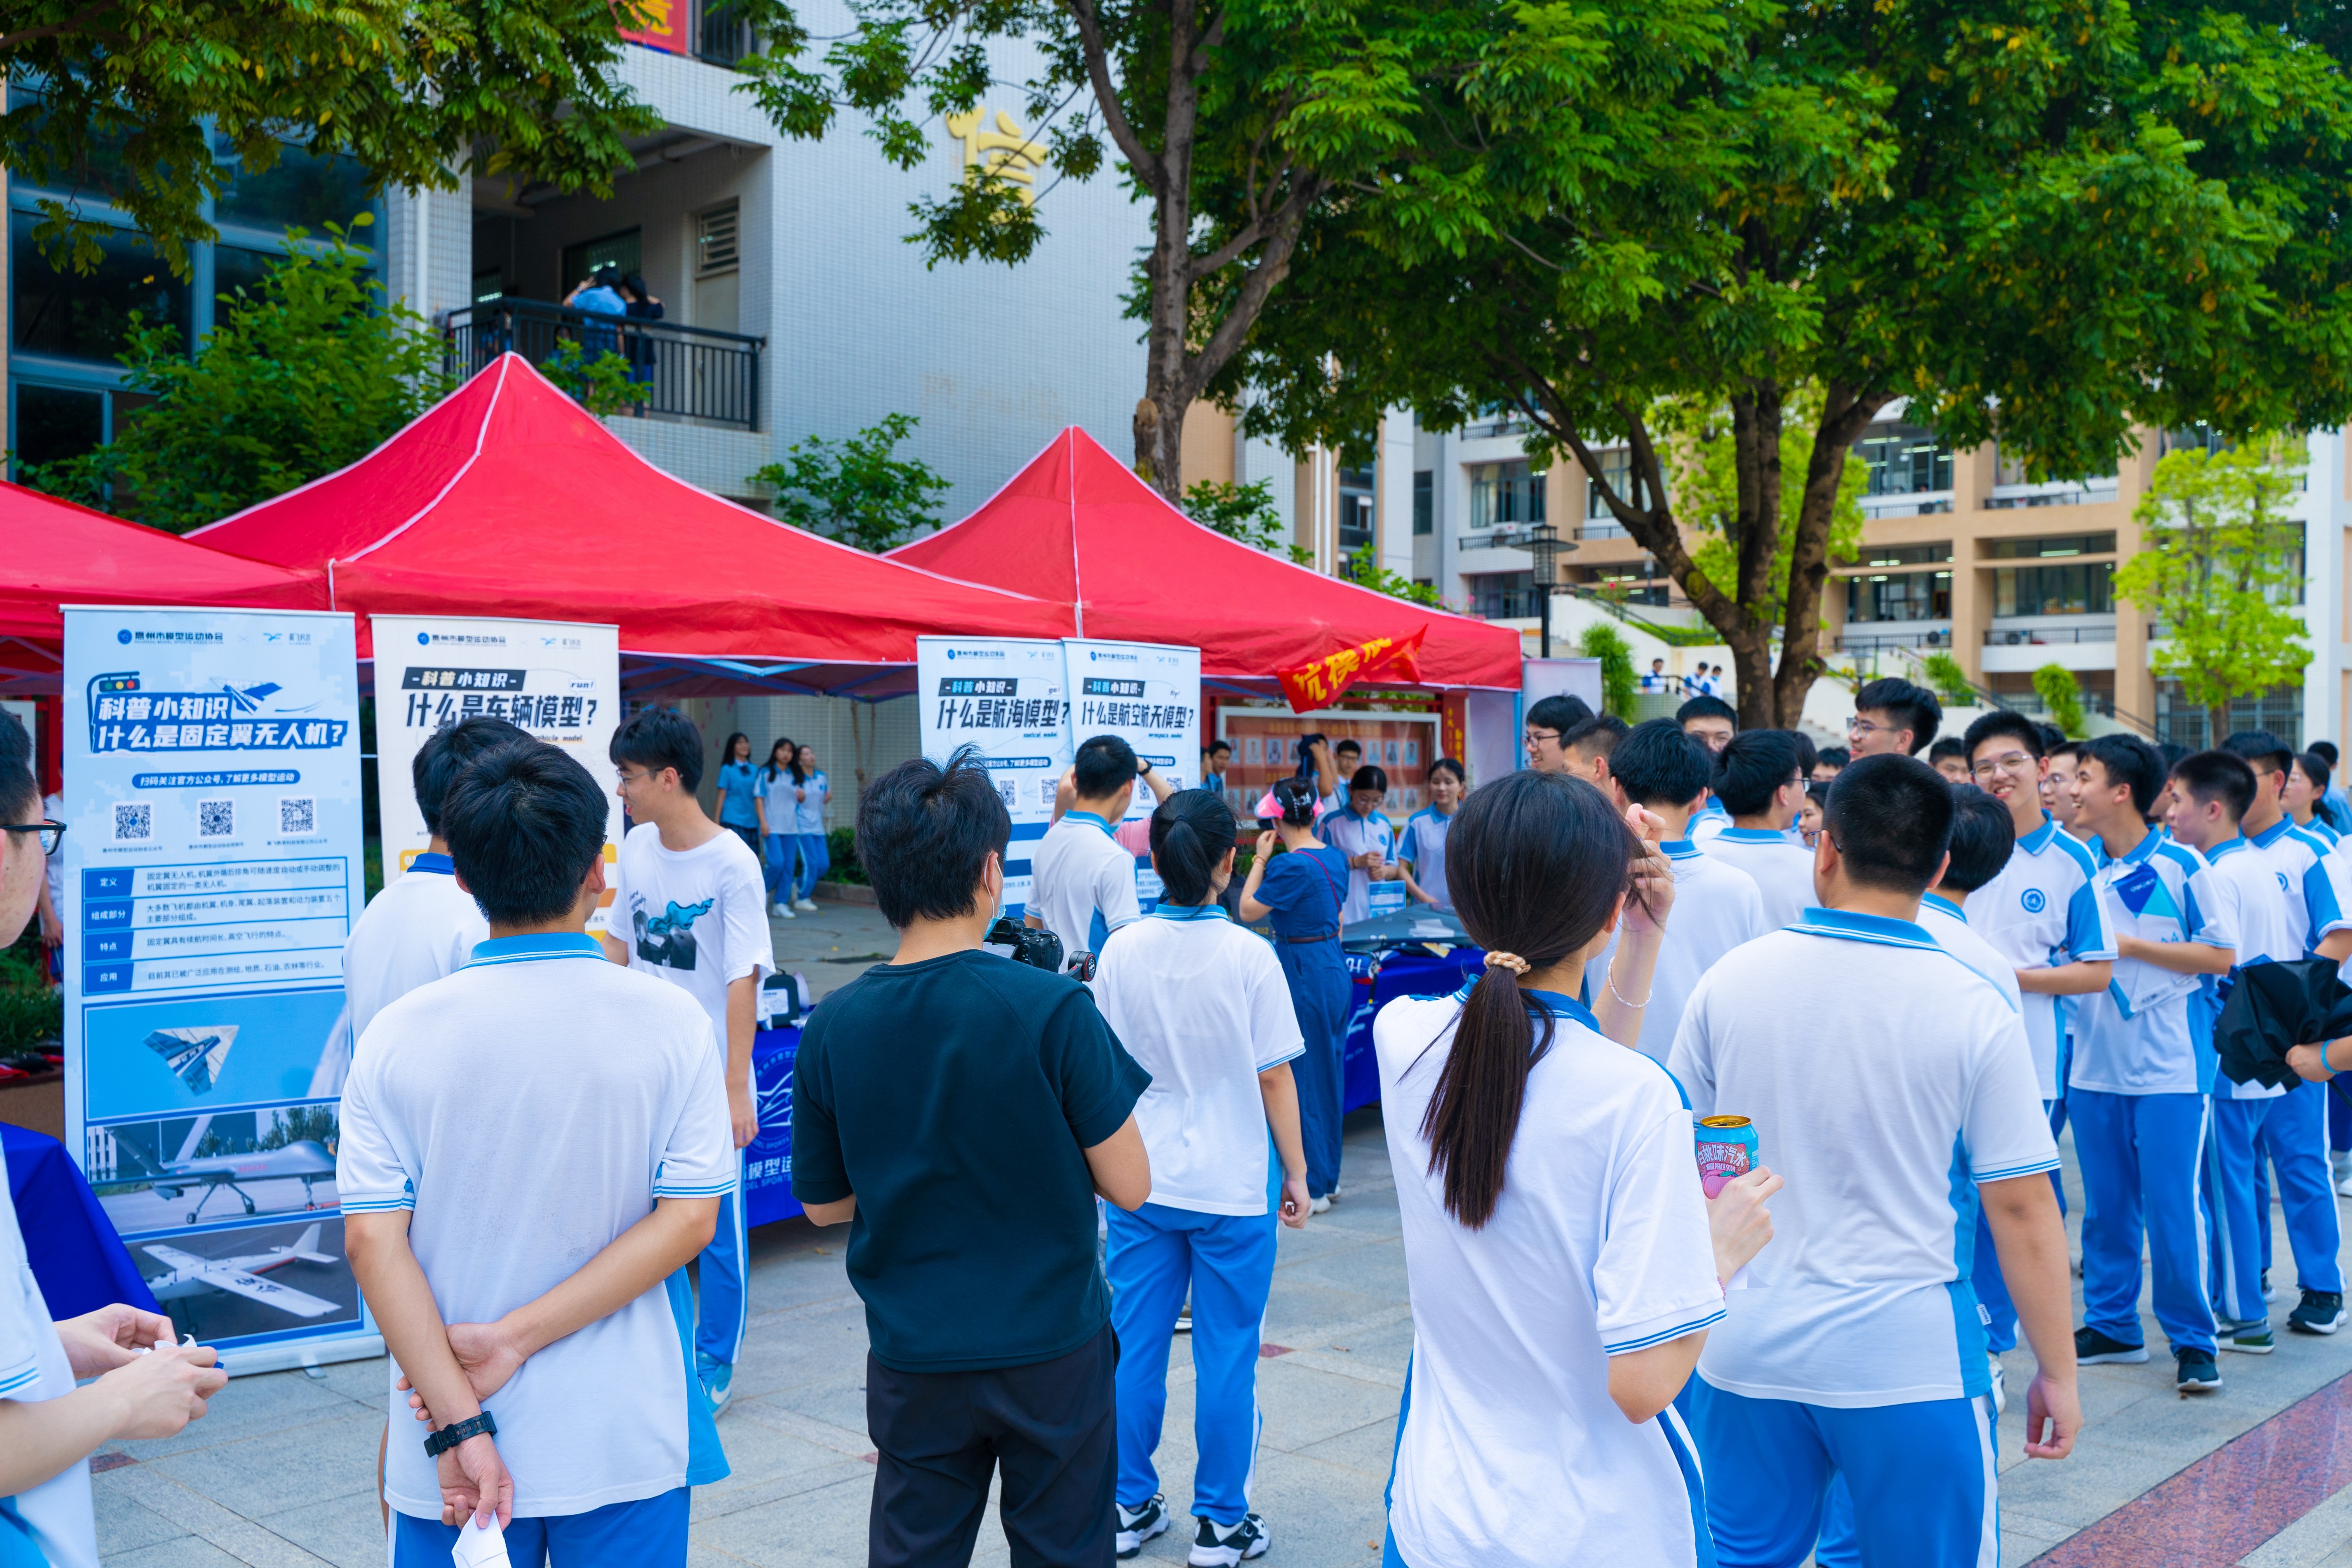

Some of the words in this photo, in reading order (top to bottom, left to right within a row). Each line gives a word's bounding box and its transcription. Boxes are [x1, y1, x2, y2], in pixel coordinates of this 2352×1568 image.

[98, 697, 230, 721] 科普小知识
[406, 693, 597, 728] 什么是车辆模型？
[937, 699, 1070, 729] 什么是航海模型？
[1082, 701, 1194, 729] 什么是航空航天模型？
[98, 723, 346, 749] 什么是固定翼无人机？
[405, 855, 416, 866] 0
[100, 877, 117, 887] 定义
[91, 909, 126, 921] 组成部分
[100, 942, 117, 952] 特点
[100, 972, 117, 982] 应用
[1698, 1144, 1747, 1167] 白桃味汽水
[745, 1155, 792, 1180] 模型运
[1726, 1164, 1736, 1172] SODA
